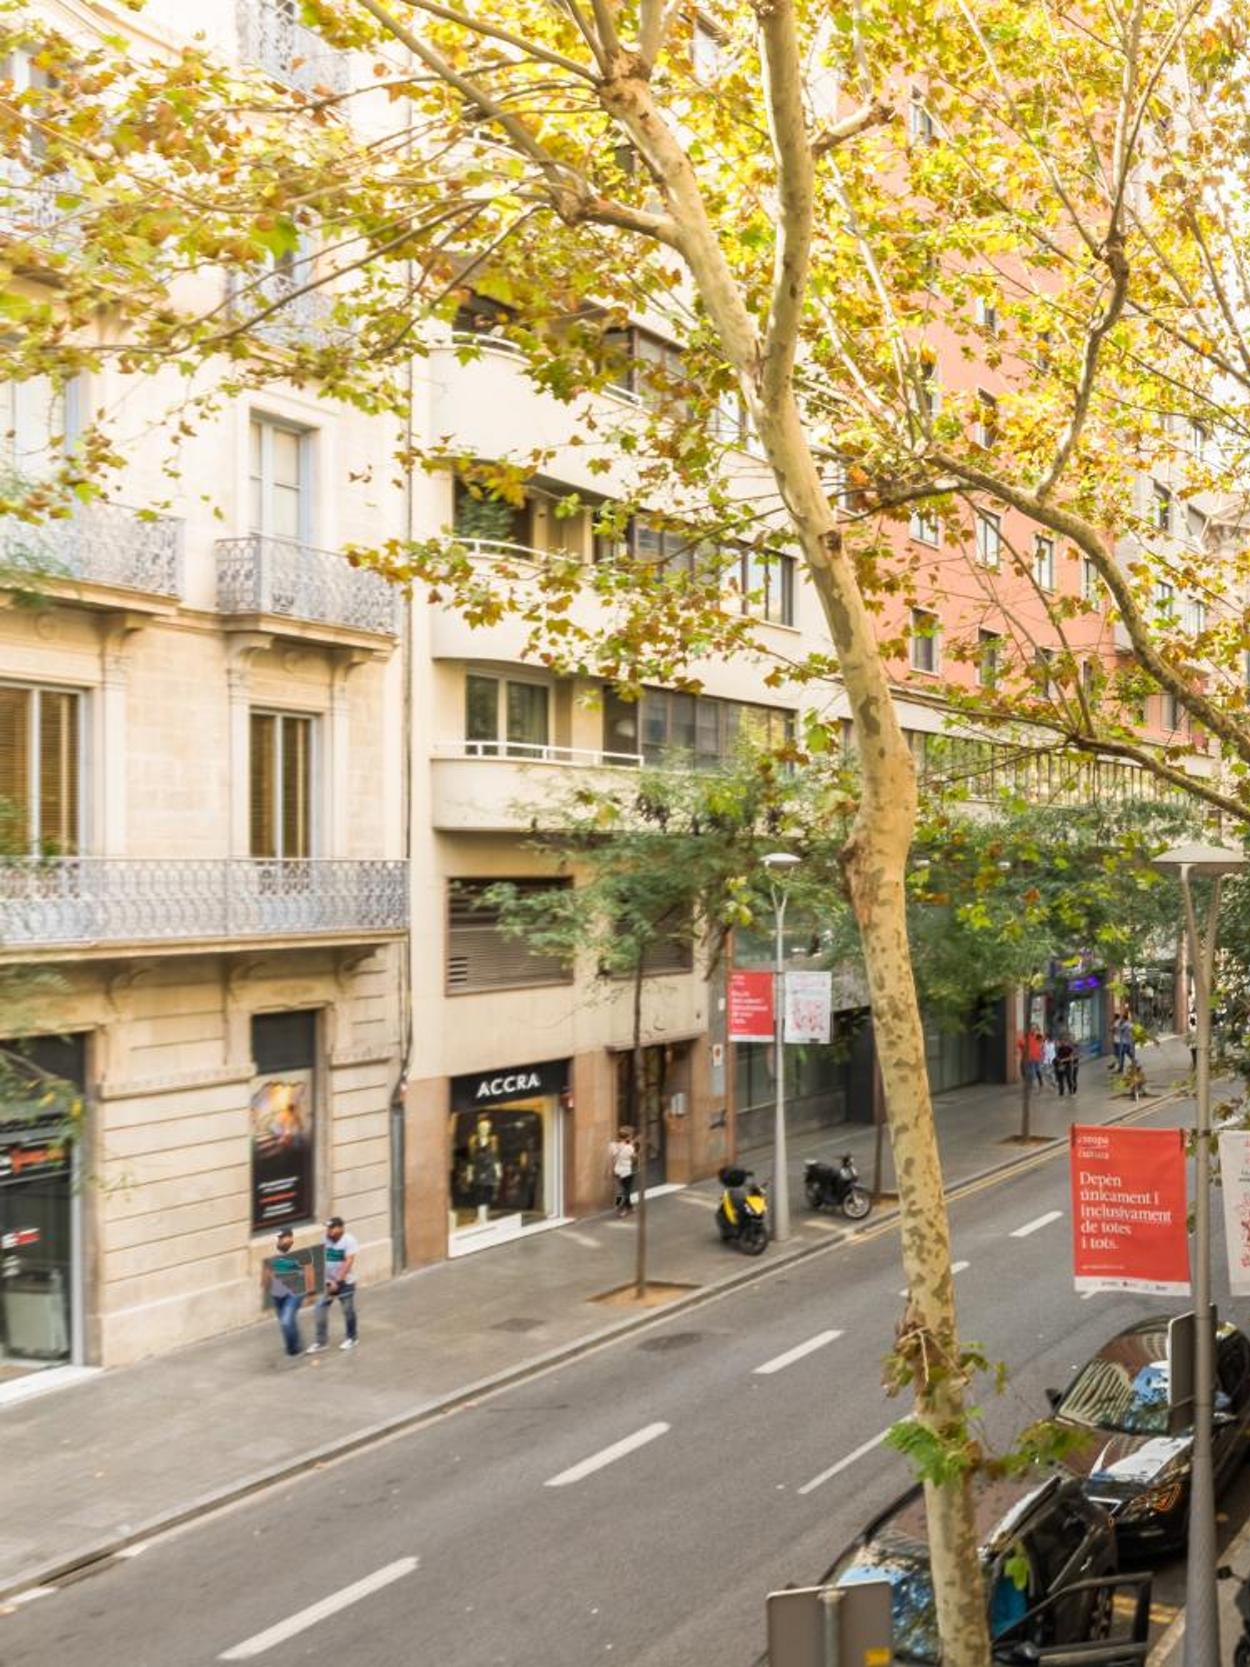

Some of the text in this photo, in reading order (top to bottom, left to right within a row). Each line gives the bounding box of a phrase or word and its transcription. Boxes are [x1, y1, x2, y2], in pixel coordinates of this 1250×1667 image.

[476, 1072, 541, 1098] ACCRA
[1081, 1220, 1132, 1235] de totes
